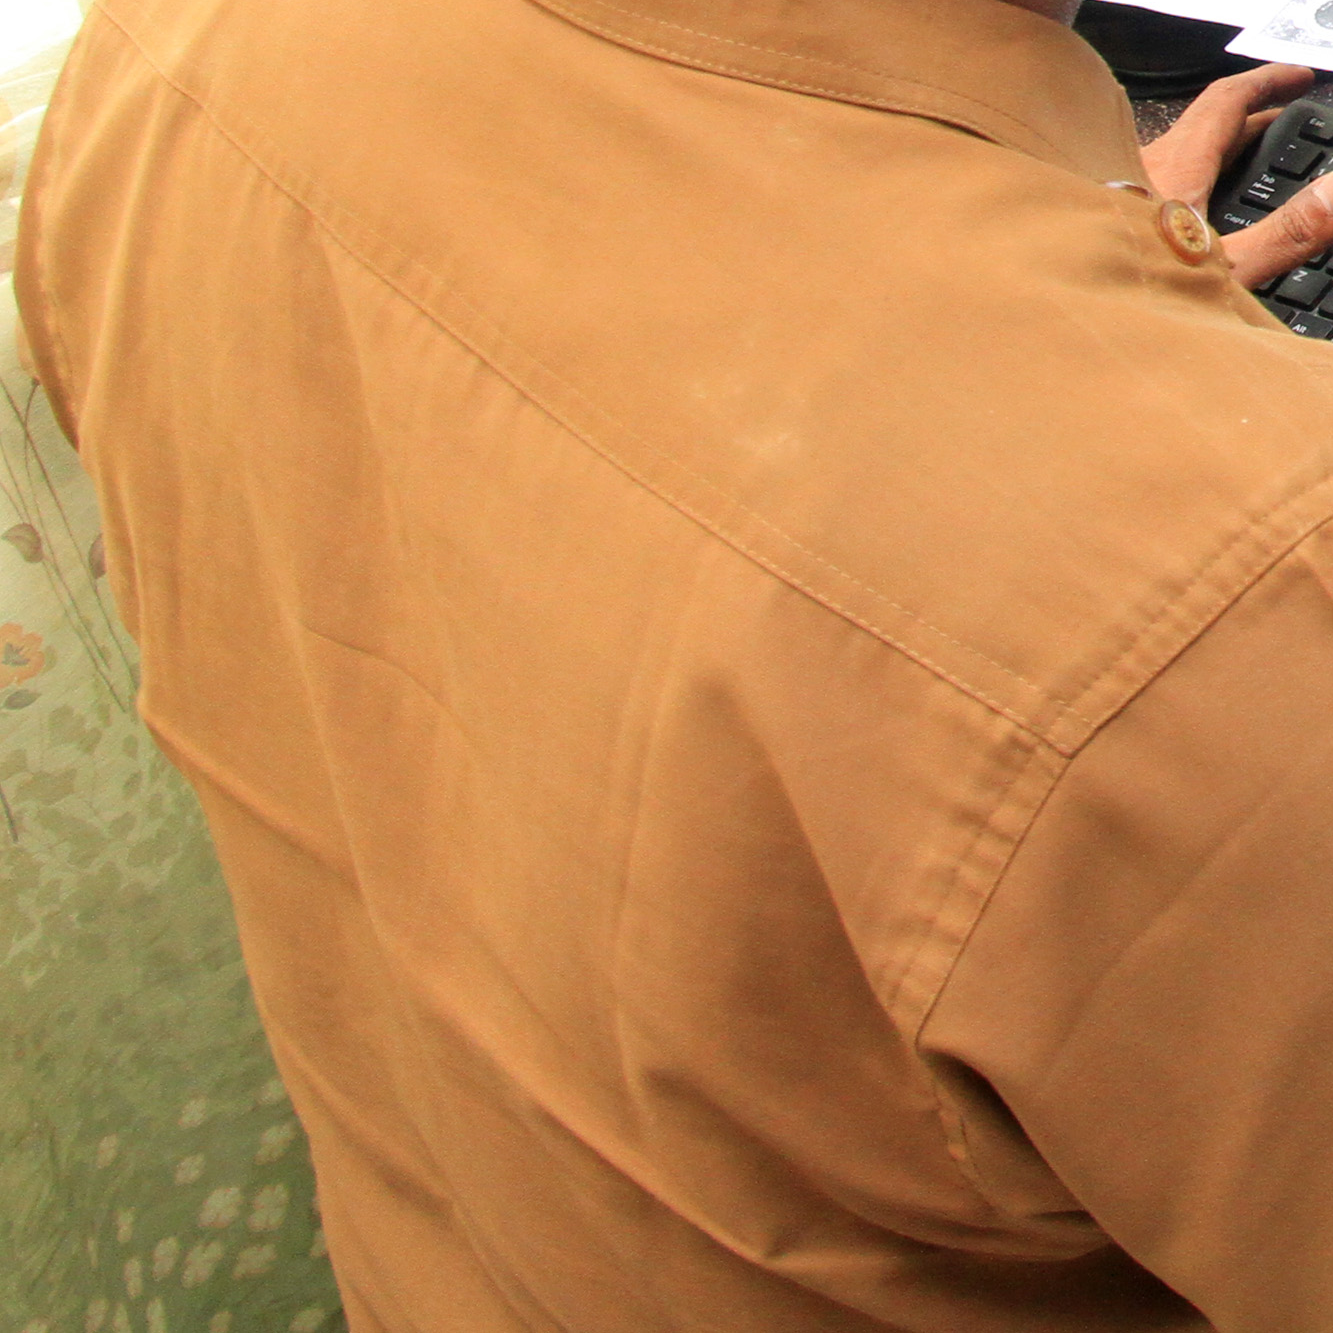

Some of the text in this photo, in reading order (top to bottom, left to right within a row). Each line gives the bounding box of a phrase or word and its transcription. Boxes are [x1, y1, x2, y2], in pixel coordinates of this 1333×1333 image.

[1261, 174, 1275, 183] Tab
[1225, 214, 1245, 224] Caps
[1293, 271, 1307, 281] Z
